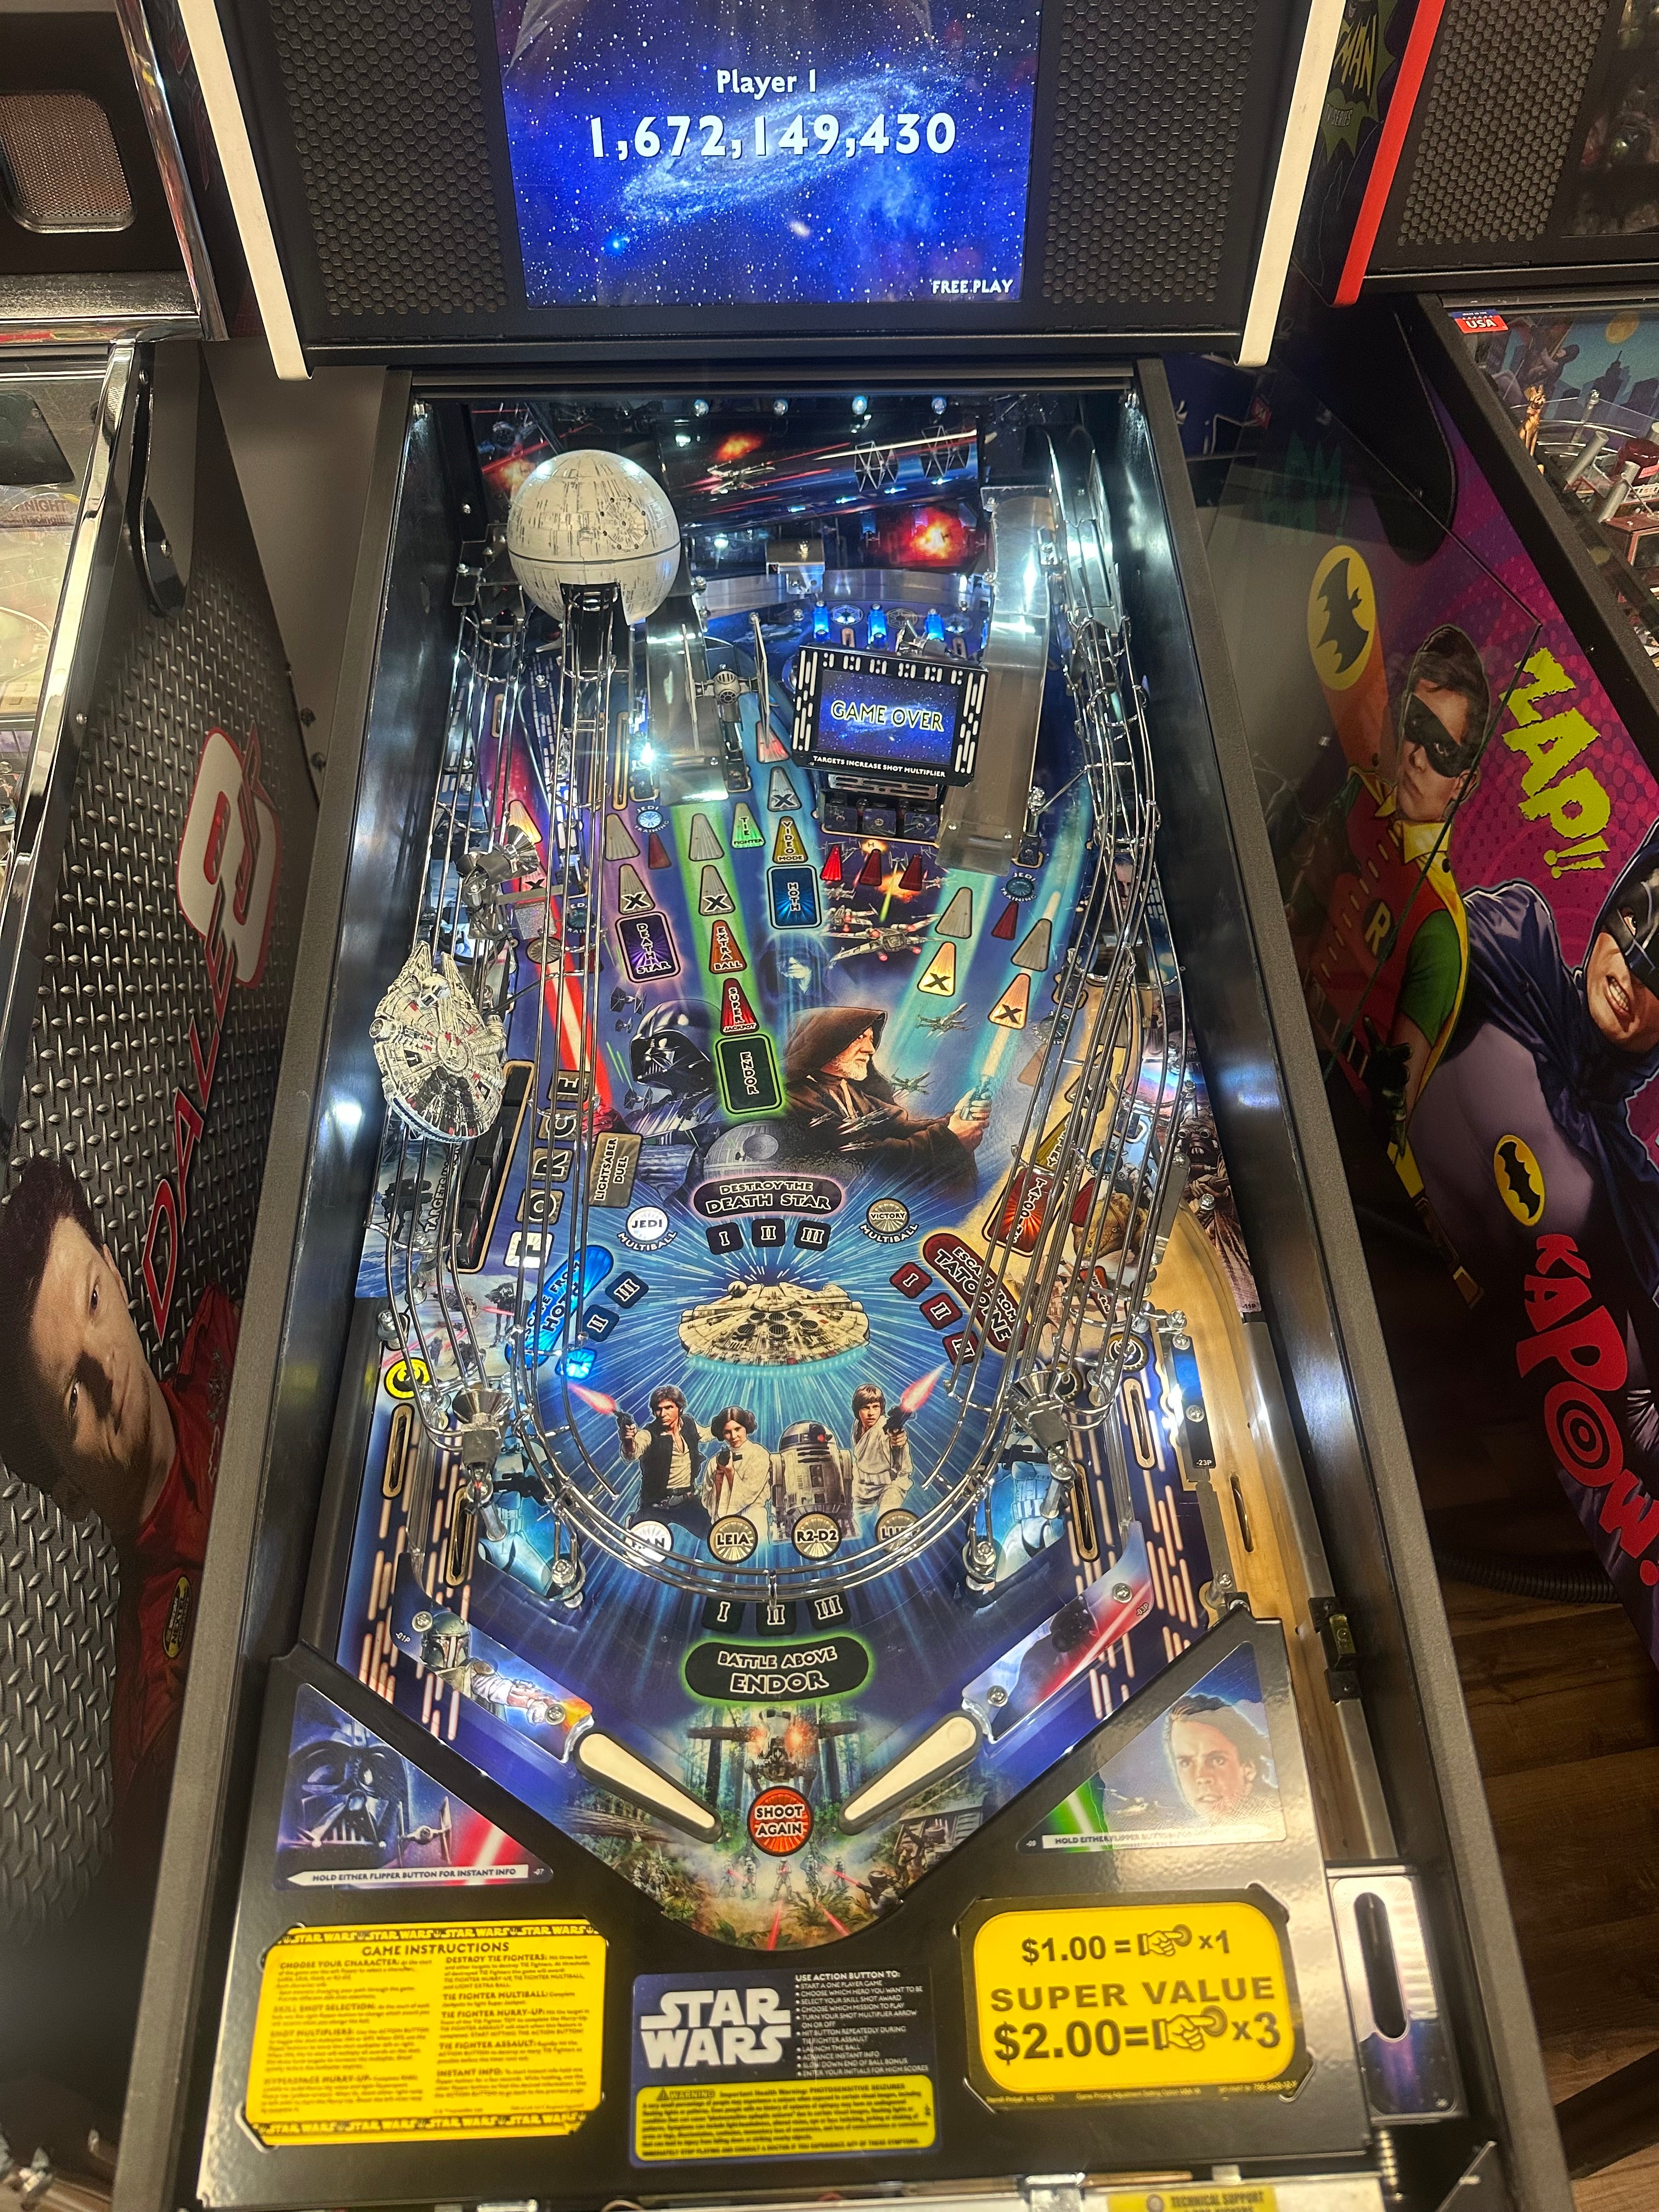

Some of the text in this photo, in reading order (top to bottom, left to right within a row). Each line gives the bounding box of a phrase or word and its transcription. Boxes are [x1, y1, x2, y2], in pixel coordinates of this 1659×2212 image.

[717, 69, 797, 100] Player
[590, 112, 957, 161] 1,672,149,430
[932, 279, 1013, 294] FREE PLAY
[1465, 319, 1497, 329] USA
[831, 699, 944, 732] GAME OVER
[813, 755, 845, 765] TARGETS
[846, 760, 882, 770] INCREASE
[883, 764, 904, 772] SHOT
[904, 767, 946, 777] MULTIPLIER
[1499, 647, 1610, 879] ZAP!!
[634, 819, 670, 833] TRAINING
[741, 816, 750, 836] TIE
[781, 821, 794, 855] VIDEO
[778, 854, 804, 862] MODE
[1013, 872, 1036, 882] JEDI
[787, 882, 800, 912] HOTH
[1000, 887, 1037, 902] TRAINING
[636, 923, 659, 966] DEATH
[716, 927, 733, 961] EXTRA
[636, 961, 672, 974] STAR
[714, 961, 743, 970] BALL
[729, 987, 744, 1024] SUPER
[723, 1024, 757, 1032] JACKPOT
[740, 1051, 759, 1095] ENDOR
[594, 1136, 619, 1201] LIGHTSABER
[612, 1155, 629, 1185] DUEL
[719, 1180, 814, 1195] DESTROY THE
[706, 1193, 831, 1214] DEATH STAR
[632, 1219, 662, 1228] JEDI
[617, 1232, 677, 1251] MULTIBALL
[800, 1227, 825, 1244] III
[860, 1224, 918, 1243] MULTIBALL
[952, 1246, 995, 1287] ESCAE
[613, 1278, 640, 1302] III
[715, 1532, 753, 1546] LEIA
[796, 1528, 838, 1543] R2-D2
[815, 1595, 843, 1621] III
[396, 1632, 411, 1643] -01P
[718, 1646, 837, 1668] BATTLE ABOVE
[730, 1671, 828, 1694] ENDOR
[755, 1804, 805, 1820] SHOOT
[755, 1821, 803, 1838] AGAIN
[1080, 1835, 1109, 1843] EITHER
[370, 1872, 400, 1880] FLIPPER
[402, 1871, 437, 1879] BUTTON
[366, 1928, 434, 1940] STAR WARS
[442, 1927, 510, 1938] STAR WARS
[518, 1926, 550, 1937] STAR
[362, 1942, 510, 1956] GAME INSTRUCTIONS
[1022, 1936, 1106, 1965] $1.00
[1199, 1929, 1230, 1954] x1
[446, 1955, 486, 1963] DESTROY
[991, 1976, 1275, 2012] SUPER VALUE
[641, 1988, 791, 2029] STAR
[1232, 2011, 1281, 2049] x3
[641, 2025, 791, 2069] WARS
